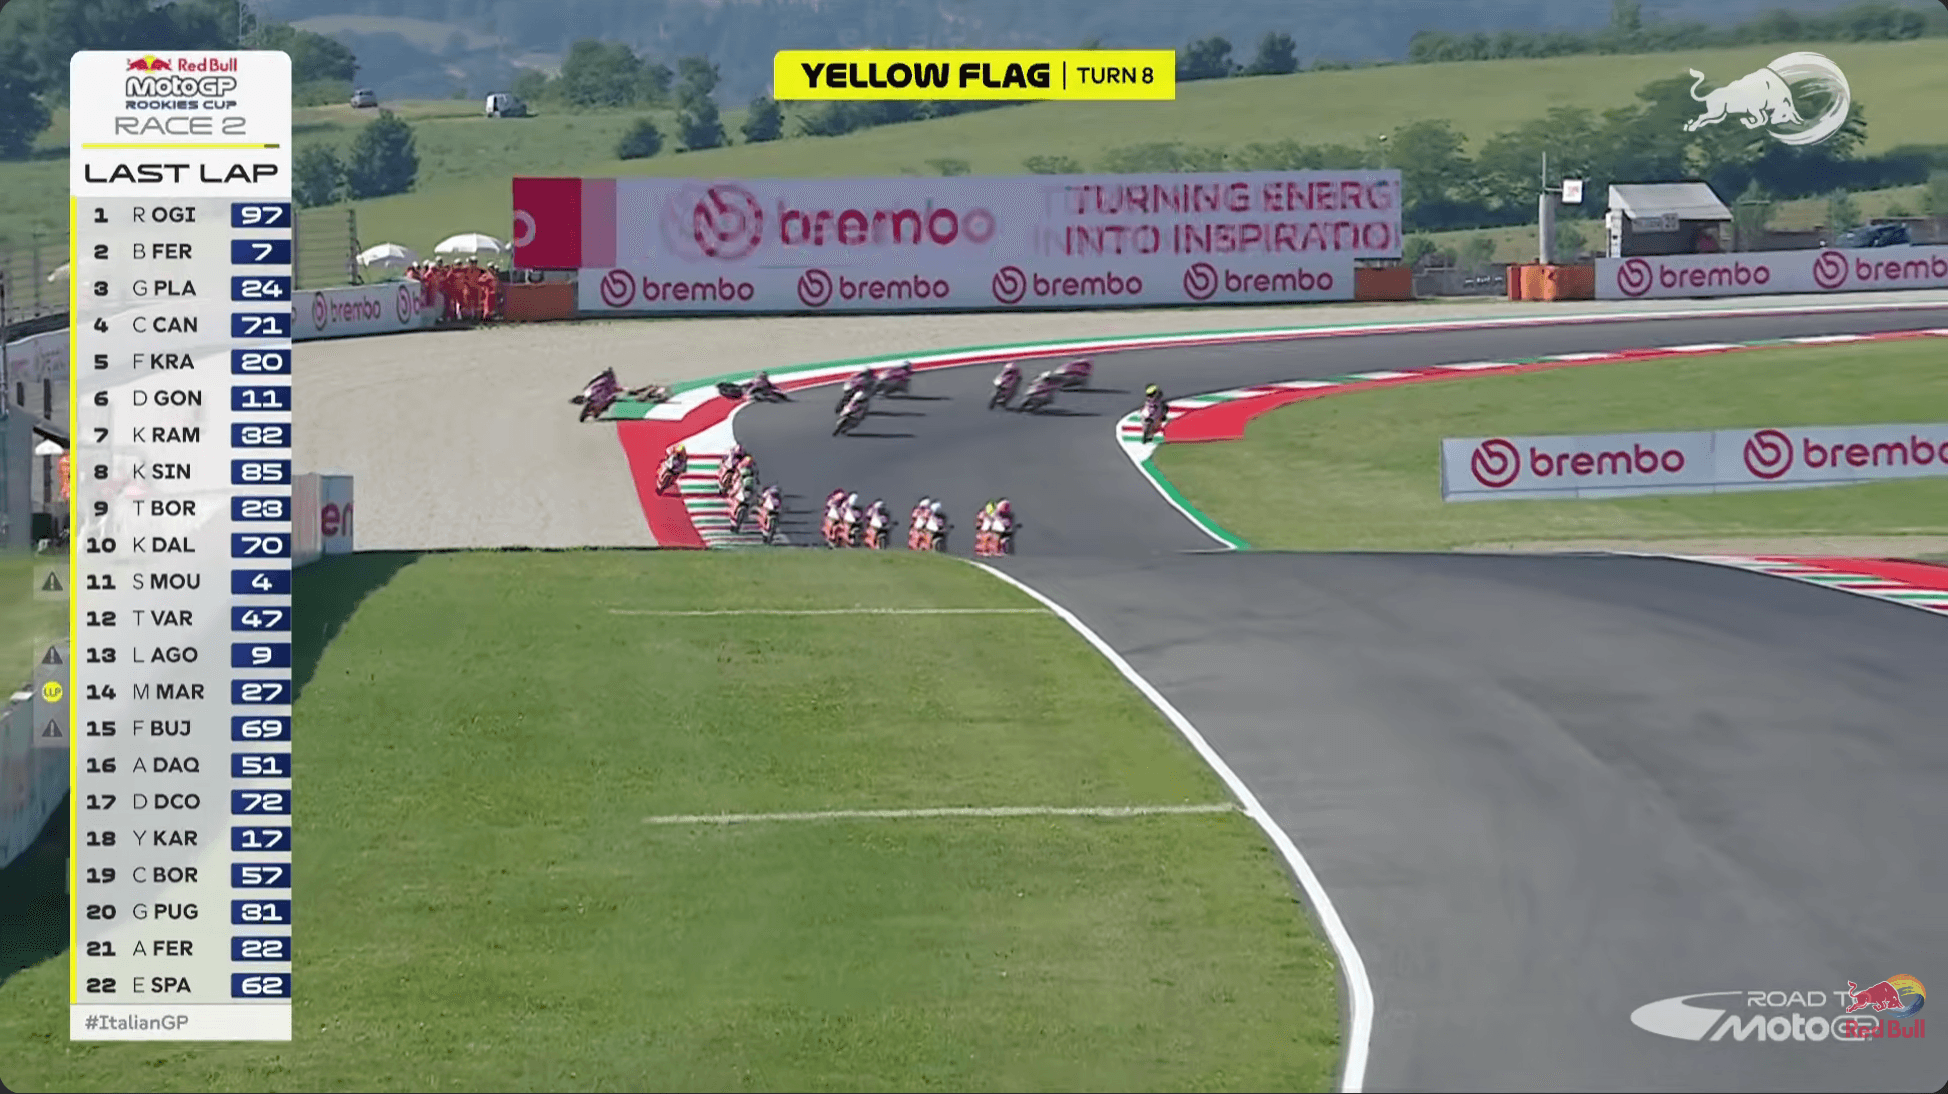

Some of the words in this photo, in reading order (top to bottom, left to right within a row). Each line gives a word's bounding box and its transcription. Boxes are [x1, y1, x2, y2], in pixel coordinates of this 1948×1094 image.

[839, 274, 950, 300] brembo
[1033, 271, 1143, 296] brembo
[1225, 267, 1333, 293] brembo
[1659, 261, 1771, 288] brembo
[642, 276, 755, 302] brembo
[331, 295, 381, 323] brembo
[1530, 444, 1686, 477] brembo
